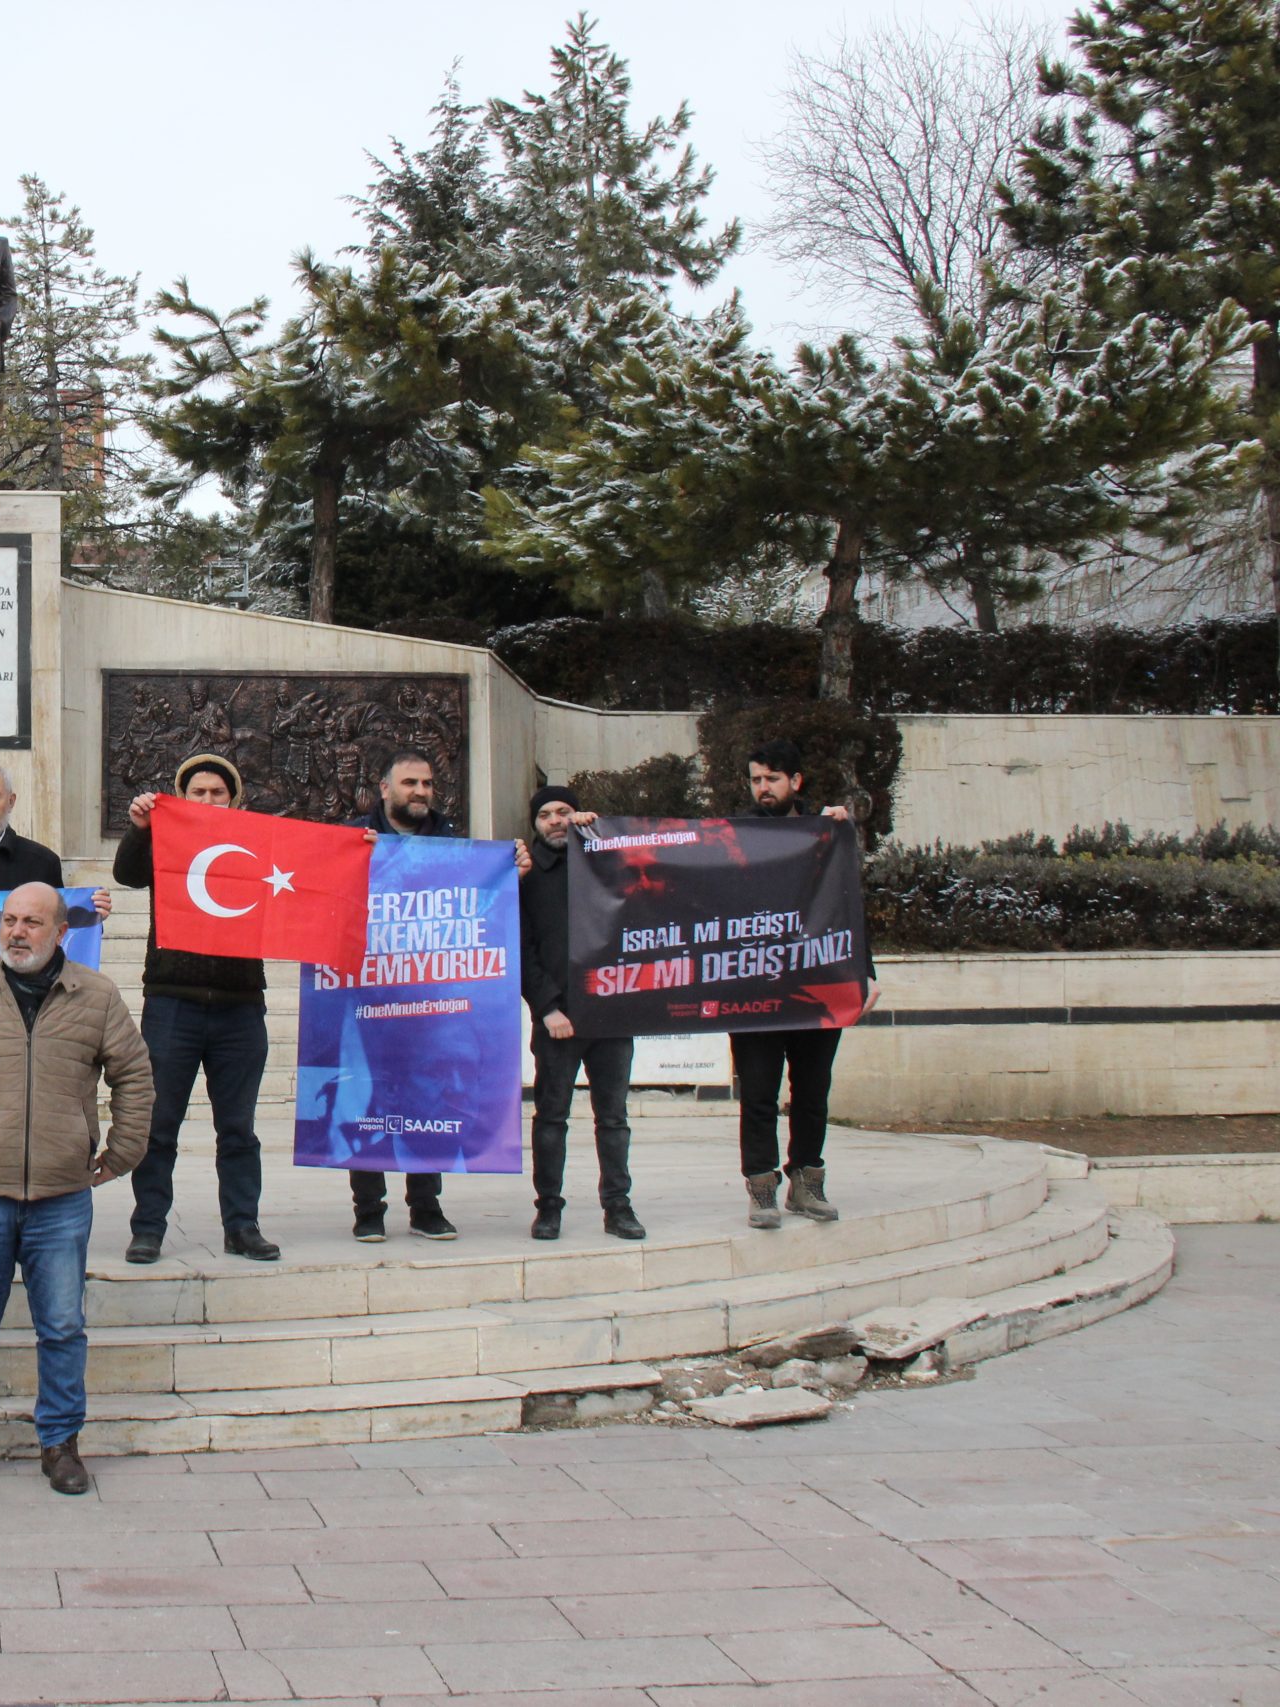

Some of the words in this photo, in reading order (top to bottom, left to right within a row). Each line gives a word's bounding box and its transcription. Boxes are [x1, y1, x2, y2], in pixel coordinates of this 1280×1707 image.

[583, 831, 697, 853] #OneMinuteErdoğan
[368, 886, 478, 924] ERZOG'U
[367, 917, 487, 955] KEMİZDE
[622, 921, 687, 953] İSRAİL
[694, 917, 721, 944] Mİ
[595, 958, 643, 998] SİZ
[653, 950, 691, 990] Mİ
[701, 927, 853, 983] DEĞİŞTİNİZ?
[355, 998, 469, 1020] #OneMinuteErdoğan
[721, 999, 783, 1015] SAADET
[404, 1119, 463, 1133] SAADET
